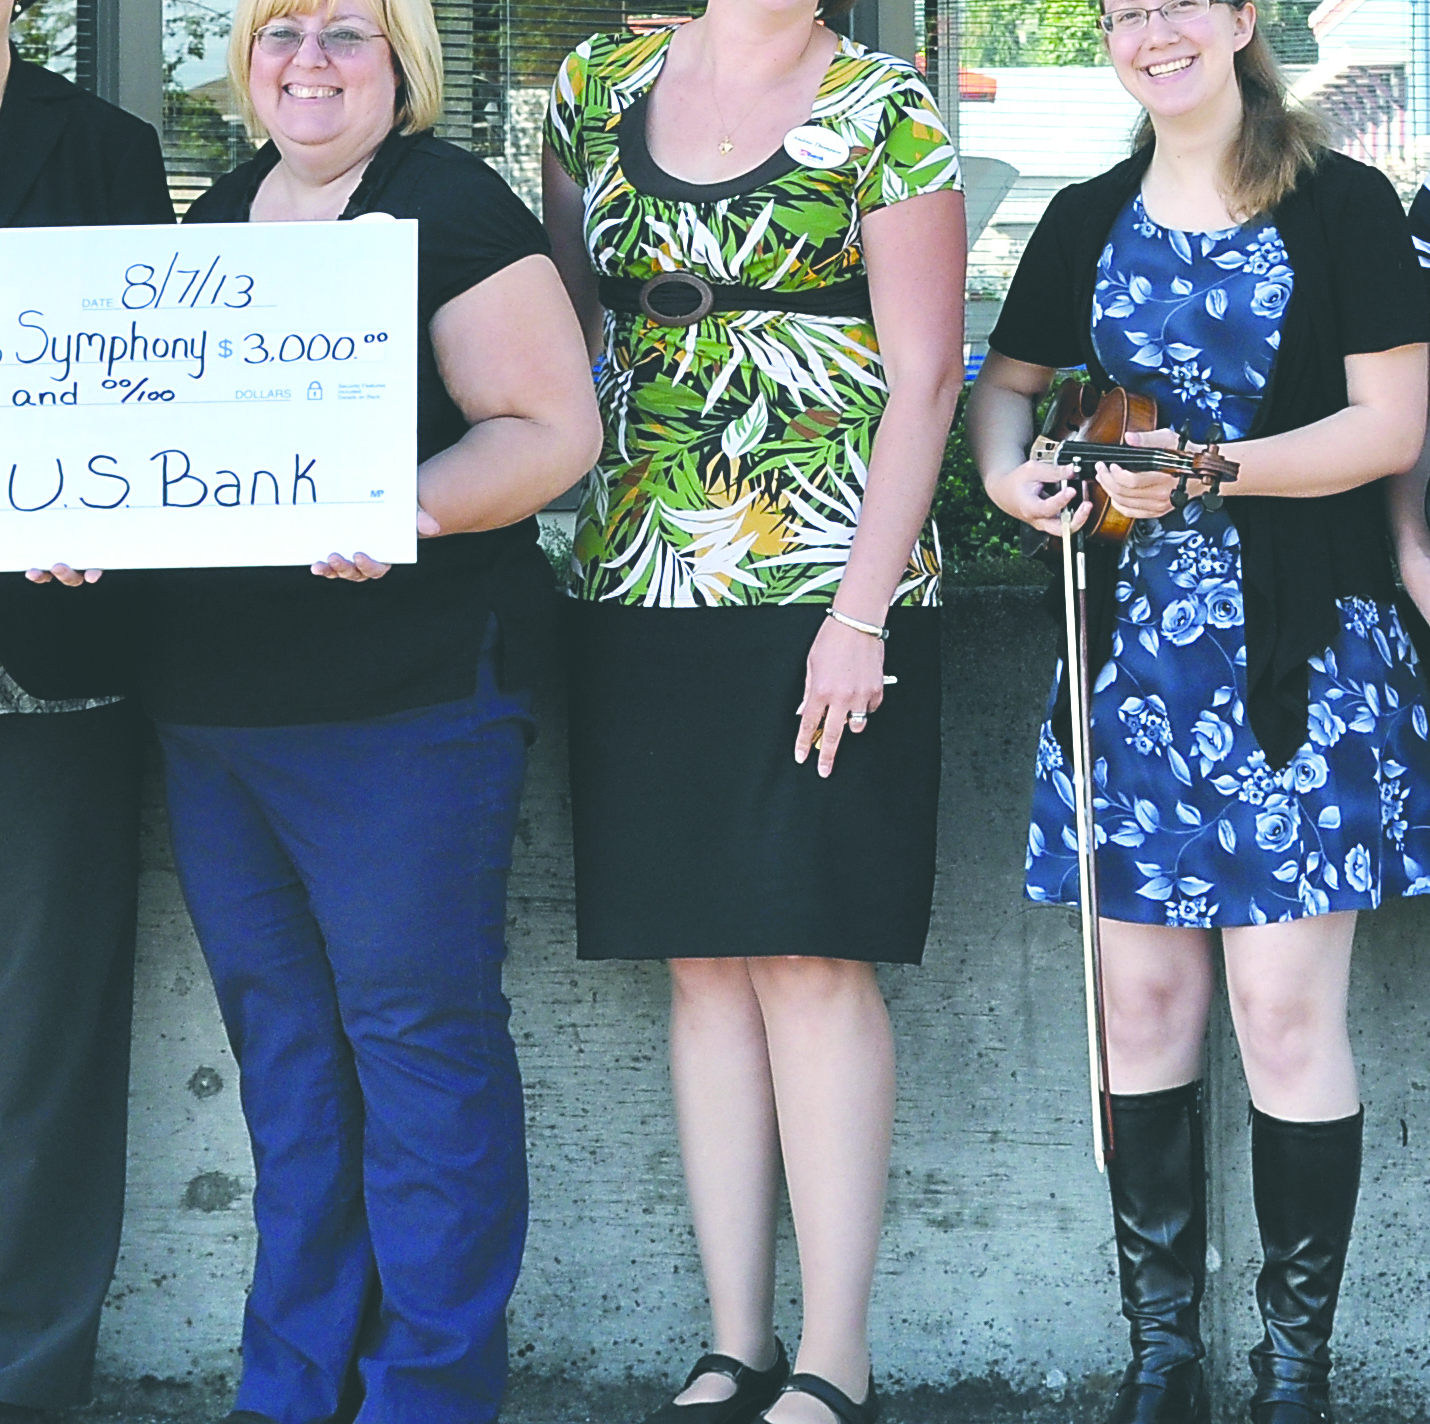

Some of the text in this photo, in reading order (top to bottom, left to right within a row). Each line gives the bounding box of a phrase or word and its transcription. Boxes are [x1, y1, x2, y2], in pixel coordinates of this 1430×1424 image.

[121, 252, 255, 310] 8/7/13
[81, 298, 113, 308] DATE
[15, 310, 207, 381] Symphony
[12, 381, 78, 407] and
[235, 389, 292, 400] DOLLARS
[150, 449, 317, 508] Bank
